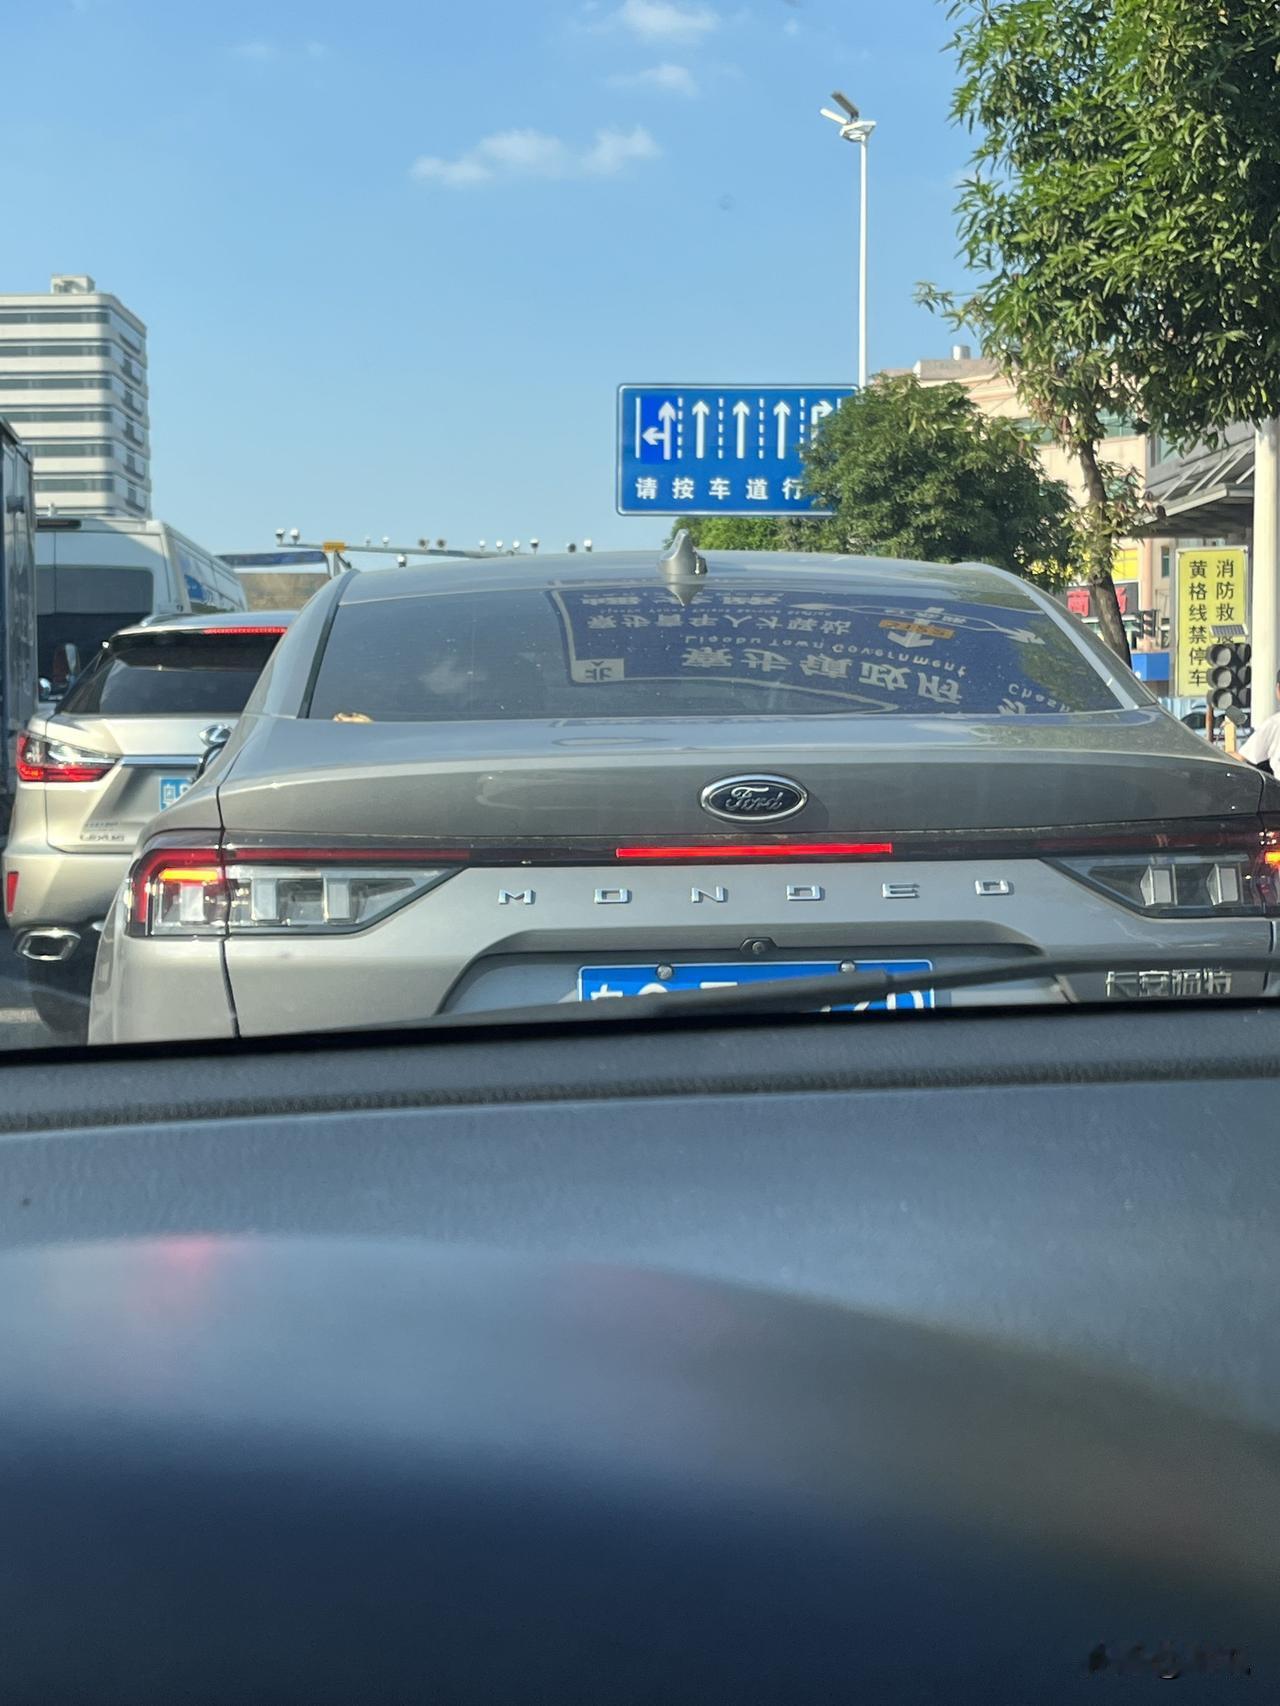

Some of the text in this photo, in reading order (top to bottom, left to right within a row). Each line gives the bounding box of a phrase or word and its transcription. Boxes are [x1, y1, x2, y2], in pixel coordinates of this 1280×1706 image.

[635, 477, 804, 500] 请按车道行
[1188, 560, 1208, 687] 黄格线禁停车
[725, 786, 783, 811] Ford
[498, 879, 1012, 904] MONDEO
